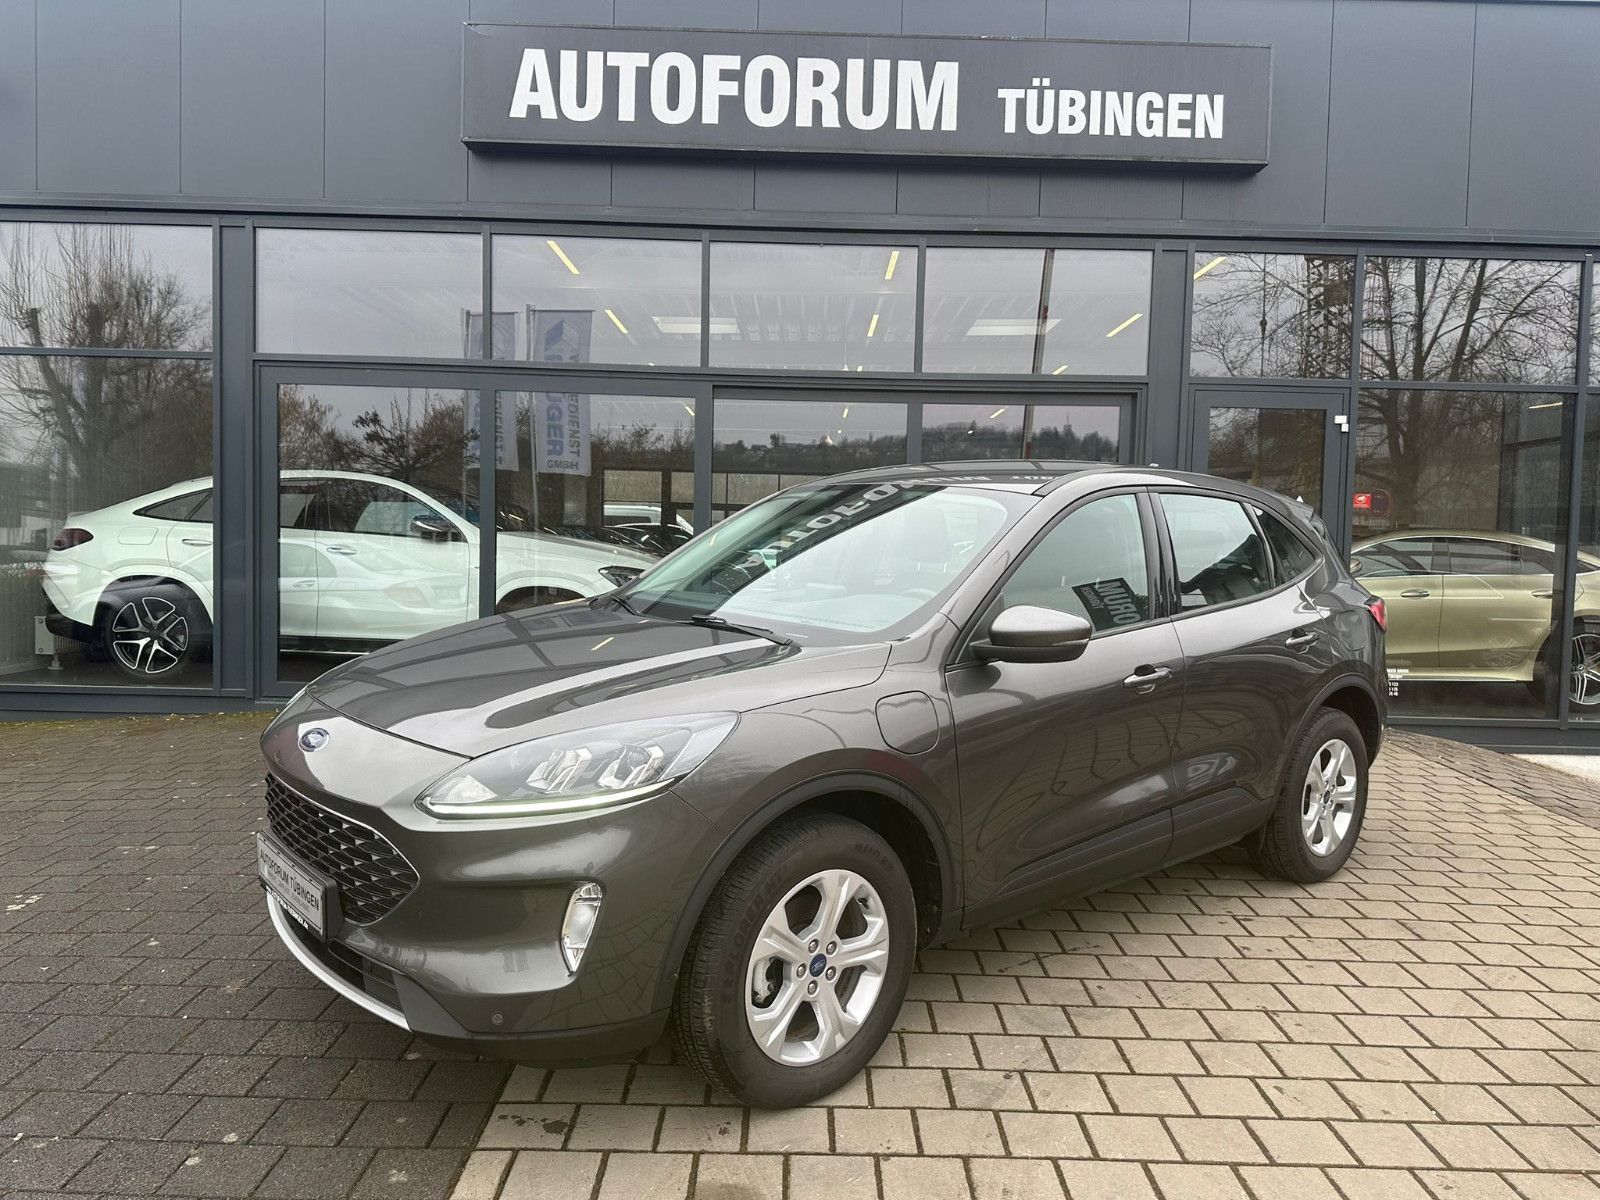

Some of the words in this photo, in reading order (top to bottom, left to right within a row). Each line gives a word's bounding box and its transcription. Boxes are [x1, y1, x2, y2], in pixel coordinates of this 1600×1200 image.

[508, 48, 959, 131] AUTOFORUM
[997, 77, 1224, 139] TÜBINGEN
[289, 875, 320, 911] TÜBINGEN
